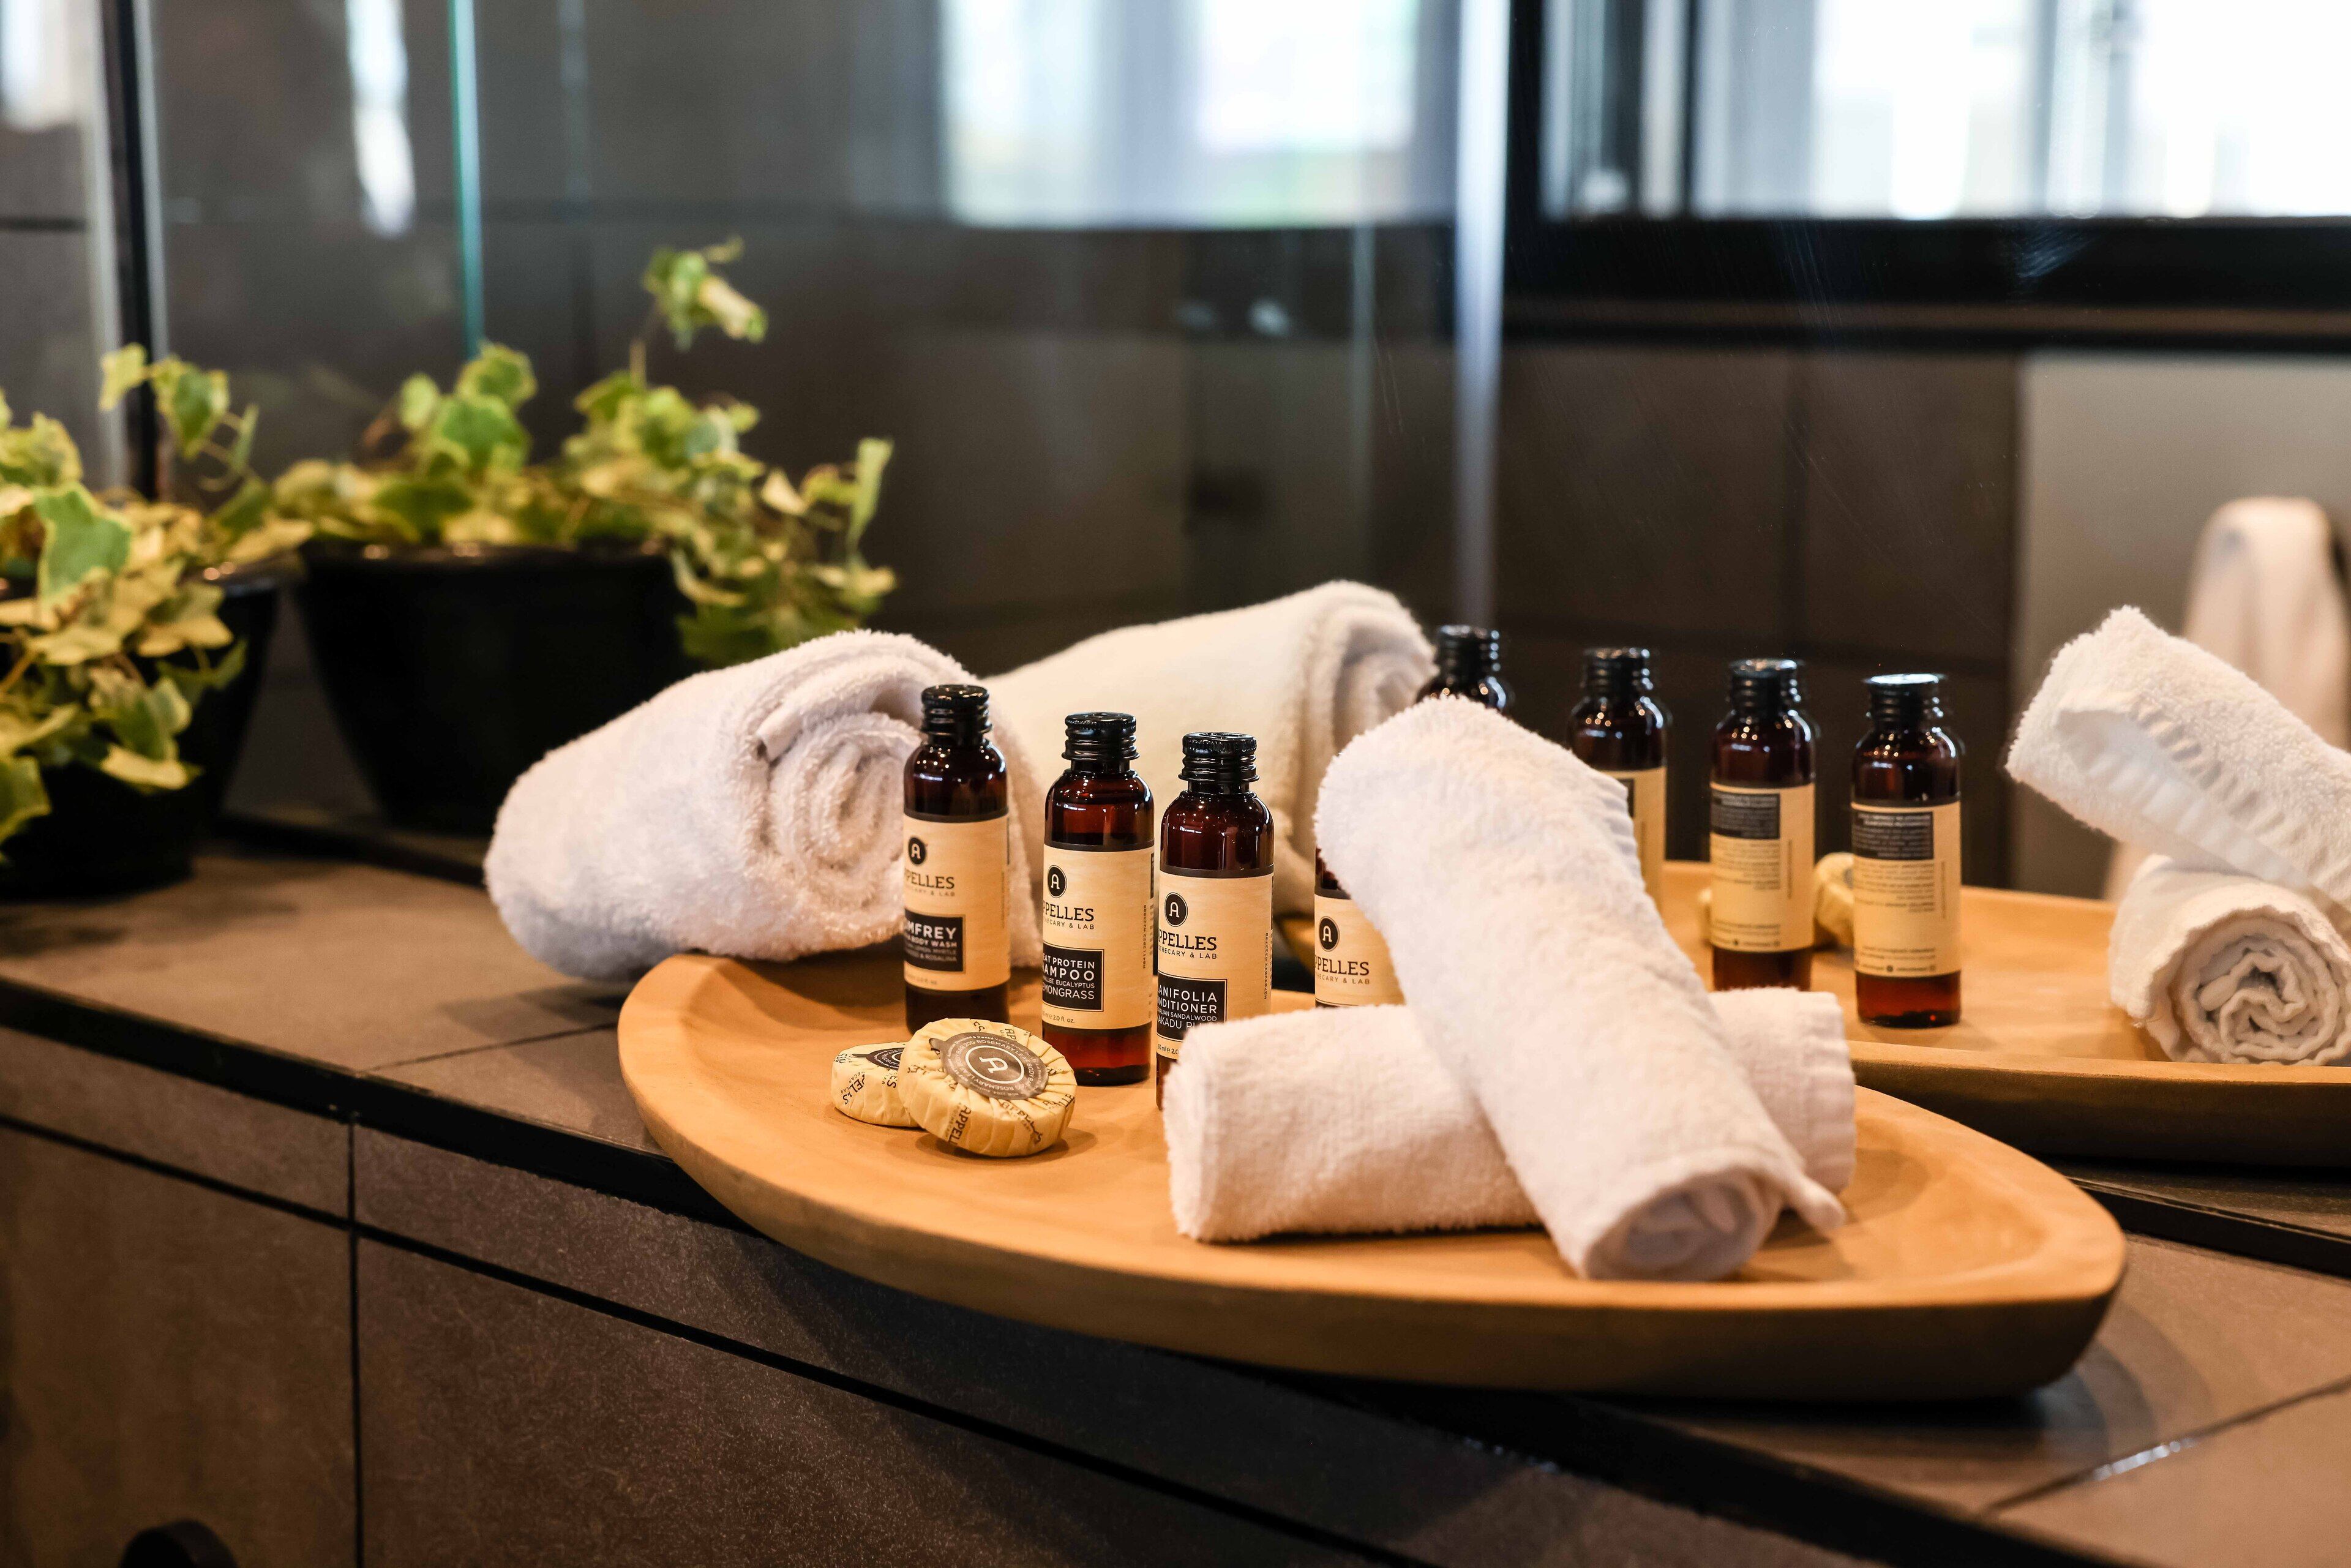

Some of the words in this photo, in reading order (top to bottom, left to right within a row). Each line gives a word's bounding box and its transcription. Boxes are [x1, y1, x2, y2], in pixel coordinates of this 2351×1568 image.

[911, 844, 921, 859] A
[1051, 874, 1060, 890] A
[1169, 901, 1180, 918] A
[1322, 925, 1332, 942] A
[1158, 945, 1185, 956] THECARY
[1052, 956, 1095, 969] PROTEIN
[1056, 980, 1095, 989] EUCALYPTUS
[1157, 985, 1217, 1002] ANIFOLIA
[1171, 1011, 1217, 1022] SANDALWOOD
[976, 1039, 1016, 1052] ROSEMARY
